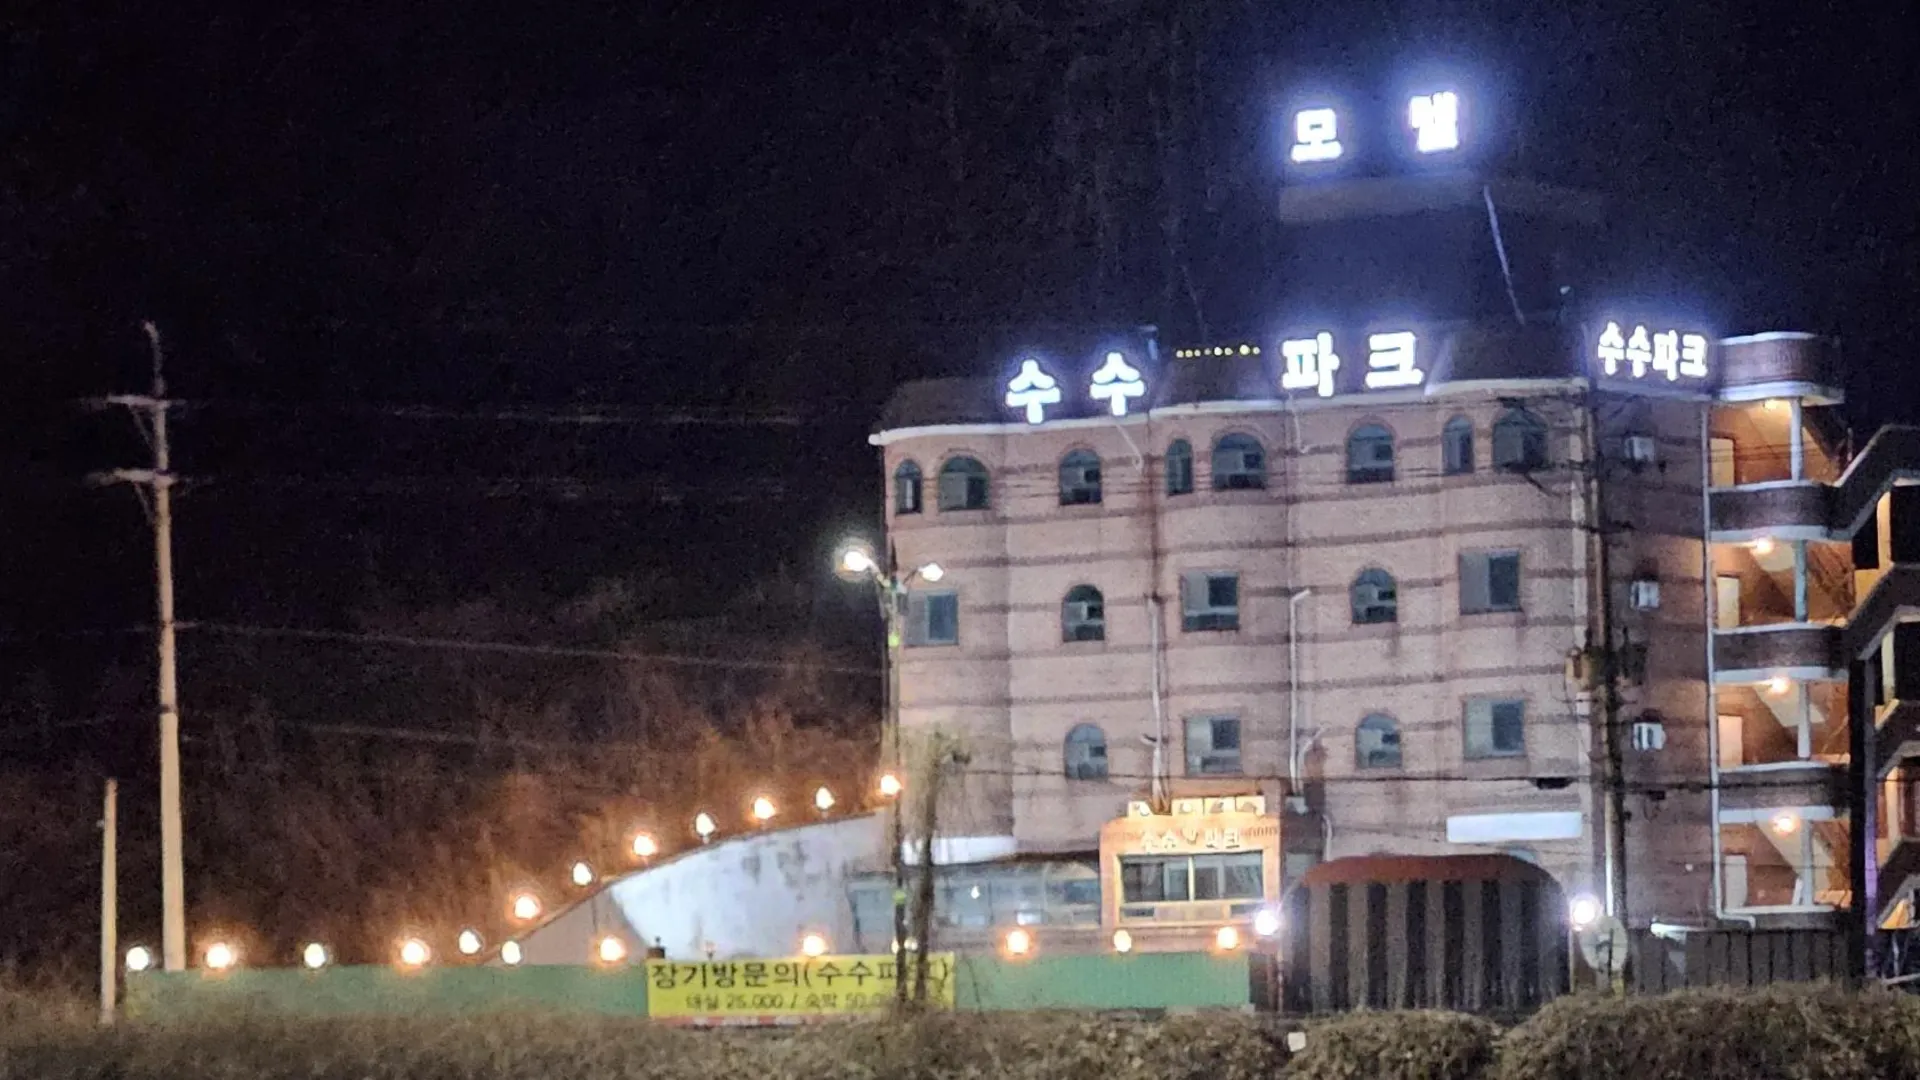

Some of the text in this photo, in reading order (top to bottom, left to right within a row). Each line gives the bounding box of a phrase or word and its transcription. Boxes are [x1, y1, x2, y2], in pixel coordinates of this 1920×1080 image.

[1290, 91, 1458, 163] 모텔
[1005, 331, 1424, 424] 수수 파크
[1597, 321, 1709, 382] 수수파크
[686, 995, 719, 1010] 대실
[845, 993, 899, 1009] 50.0
